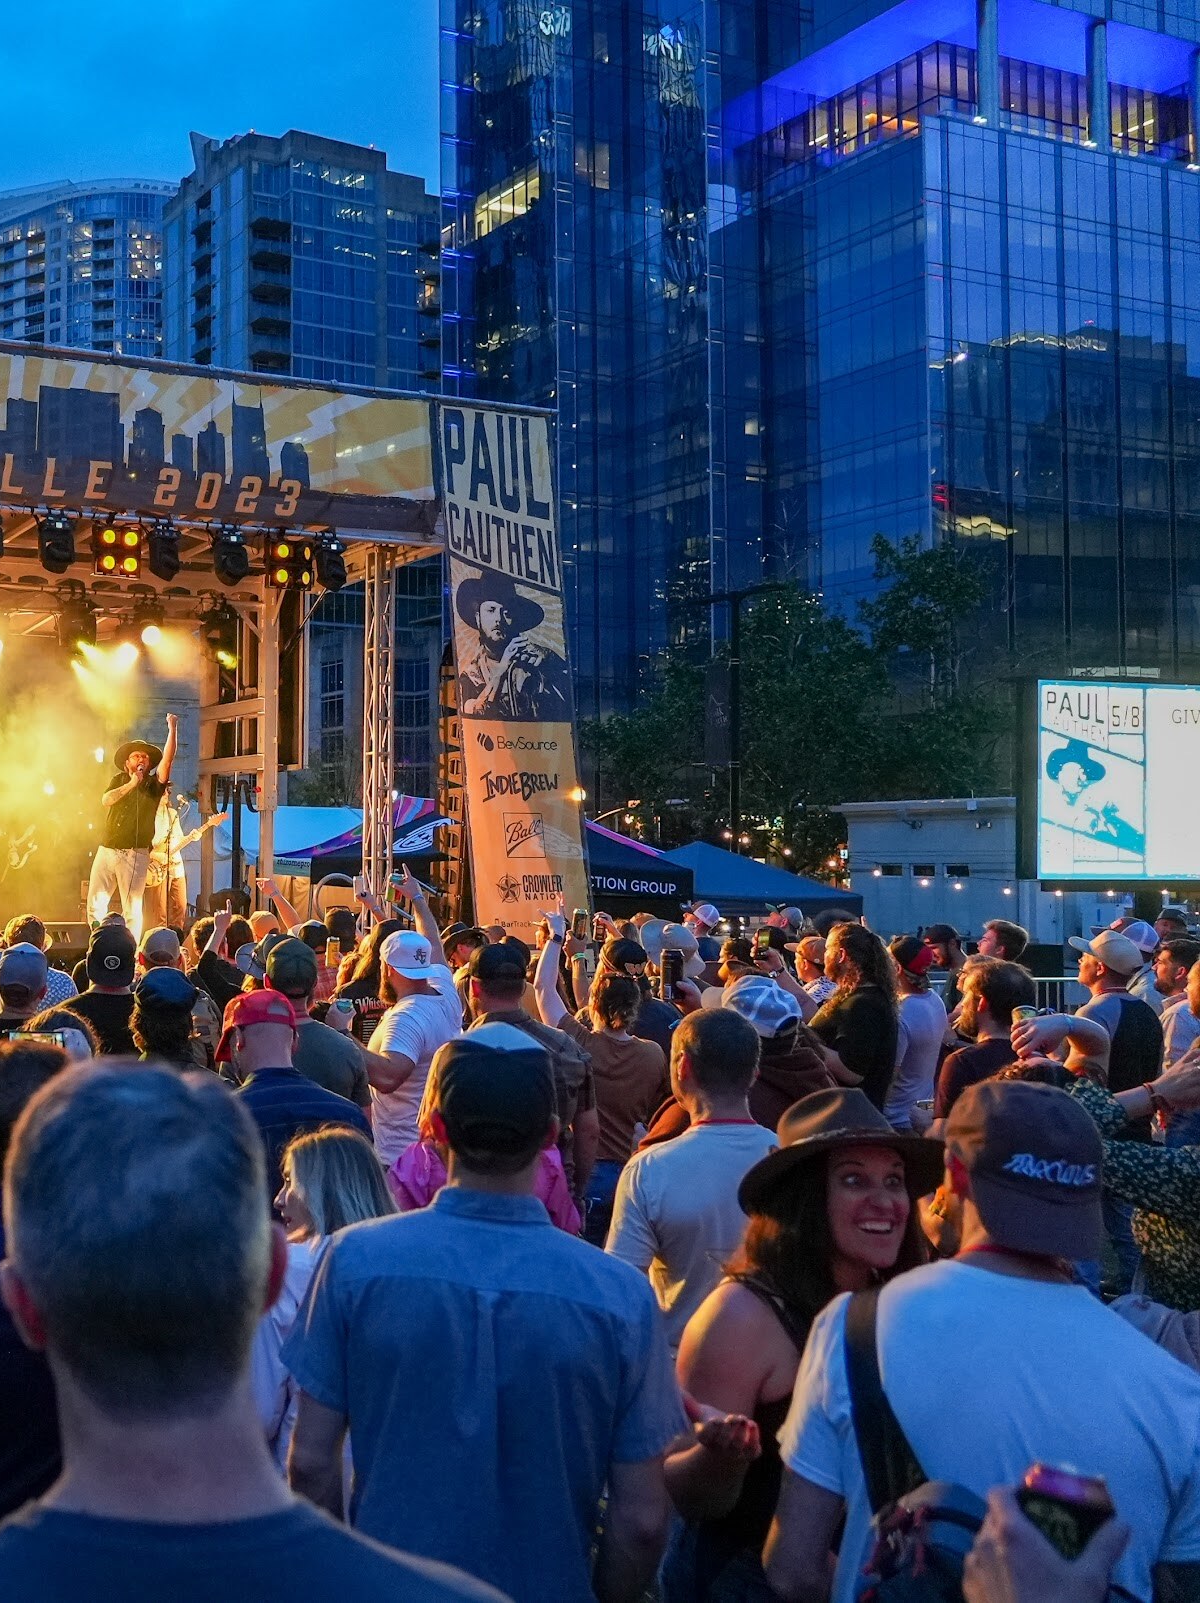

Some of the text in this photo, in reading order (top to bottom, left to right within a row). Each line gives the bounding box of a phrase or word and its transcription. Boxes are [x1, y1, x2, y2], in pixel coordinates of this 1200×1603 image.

[443, 408, 550, 520] PAUL
[155, 468, 302, 517] 2023
[449, 501, 557, 588] CAUTHEN
[1046, 691, 1105, 724] PAUL
[1111, 705, 1140, 728] 5/8
[496, 735, 558, 751] BevSource
[506, 819, 545, 845] Ball
[522, 875, 563, 893] CROWLER
[630, 879, 677, 895] GROUP
[525, 893, 557, 901] NATIO
